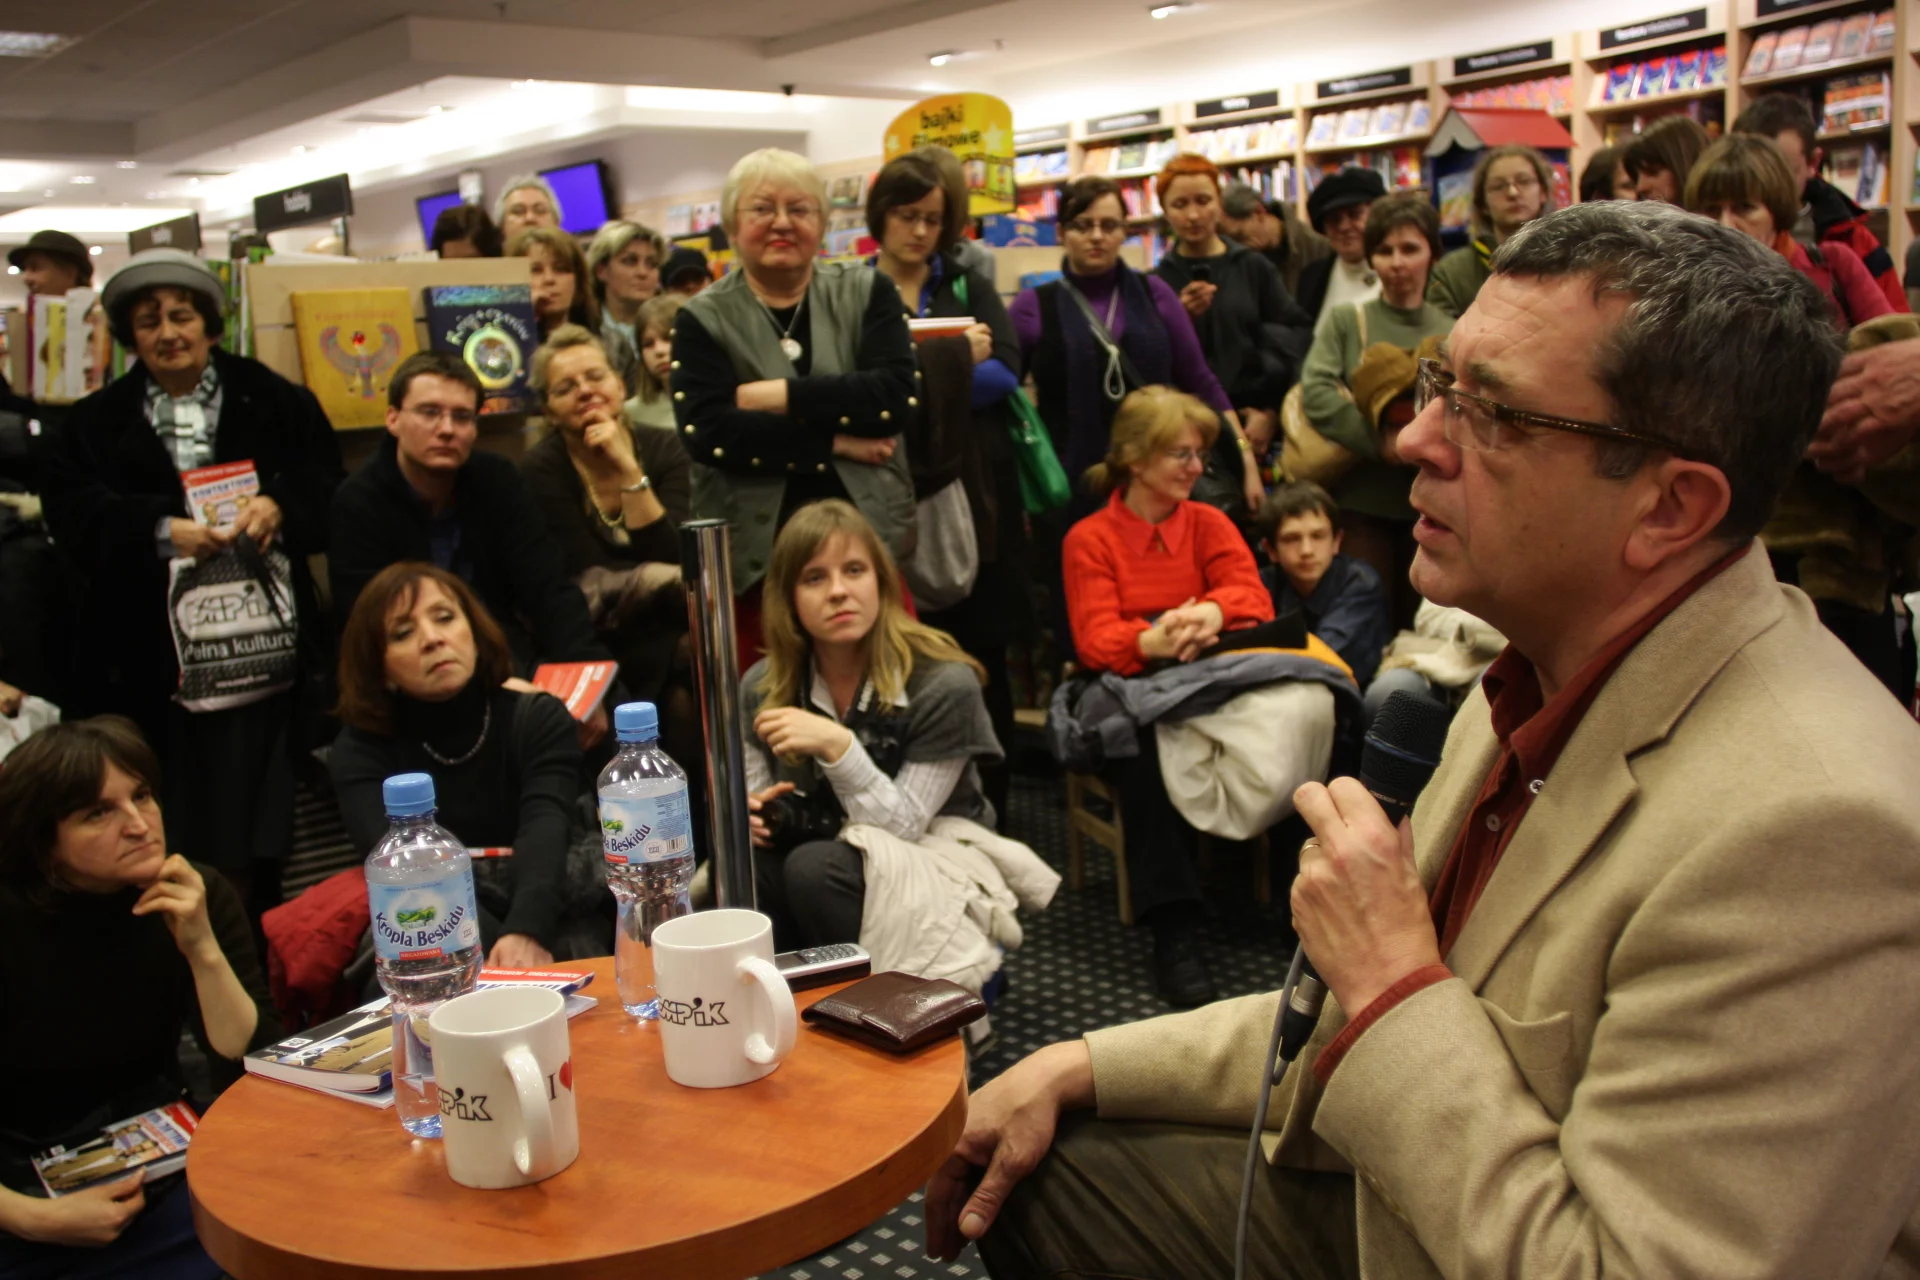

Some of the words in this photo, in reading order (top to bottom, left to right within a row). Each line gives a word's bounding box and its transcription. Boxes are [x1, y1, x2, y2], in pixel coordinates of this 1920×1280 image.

[610, 823, 652, 853] Beskidu
[375, 911, 414, 948] Kropla
[416, 904, 465, 947] Beskidu
[547, 1072, 557, 1101] I
